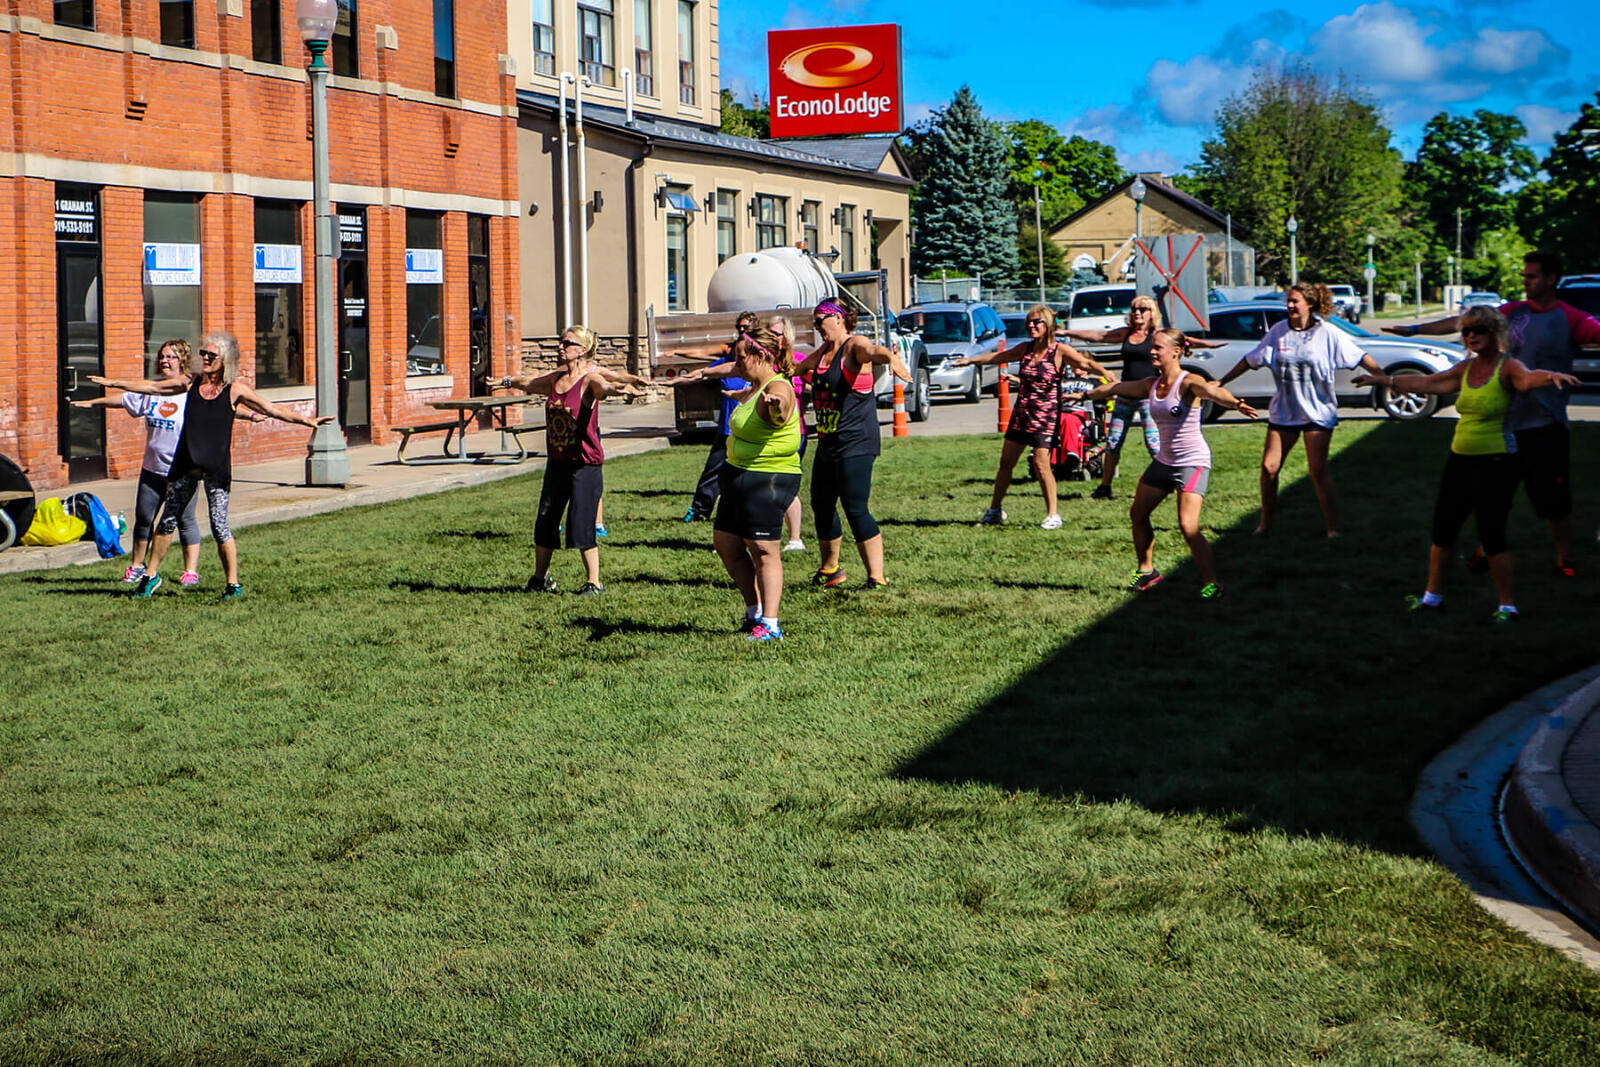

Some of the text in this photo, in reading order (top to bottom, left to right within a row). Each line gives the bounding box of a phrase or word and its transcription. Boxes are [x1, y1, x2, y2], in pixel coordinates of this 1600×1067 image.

[776, 91, 891, 118] EconoLodge
[60, 200, 85, 212] GRAHAM
[145, 271, 174, 283] DENTURE
[255, 270, 280, 281] DENTURE
[147, 401, 158, 416] I
[147, 417, 176, 430] LIFE
